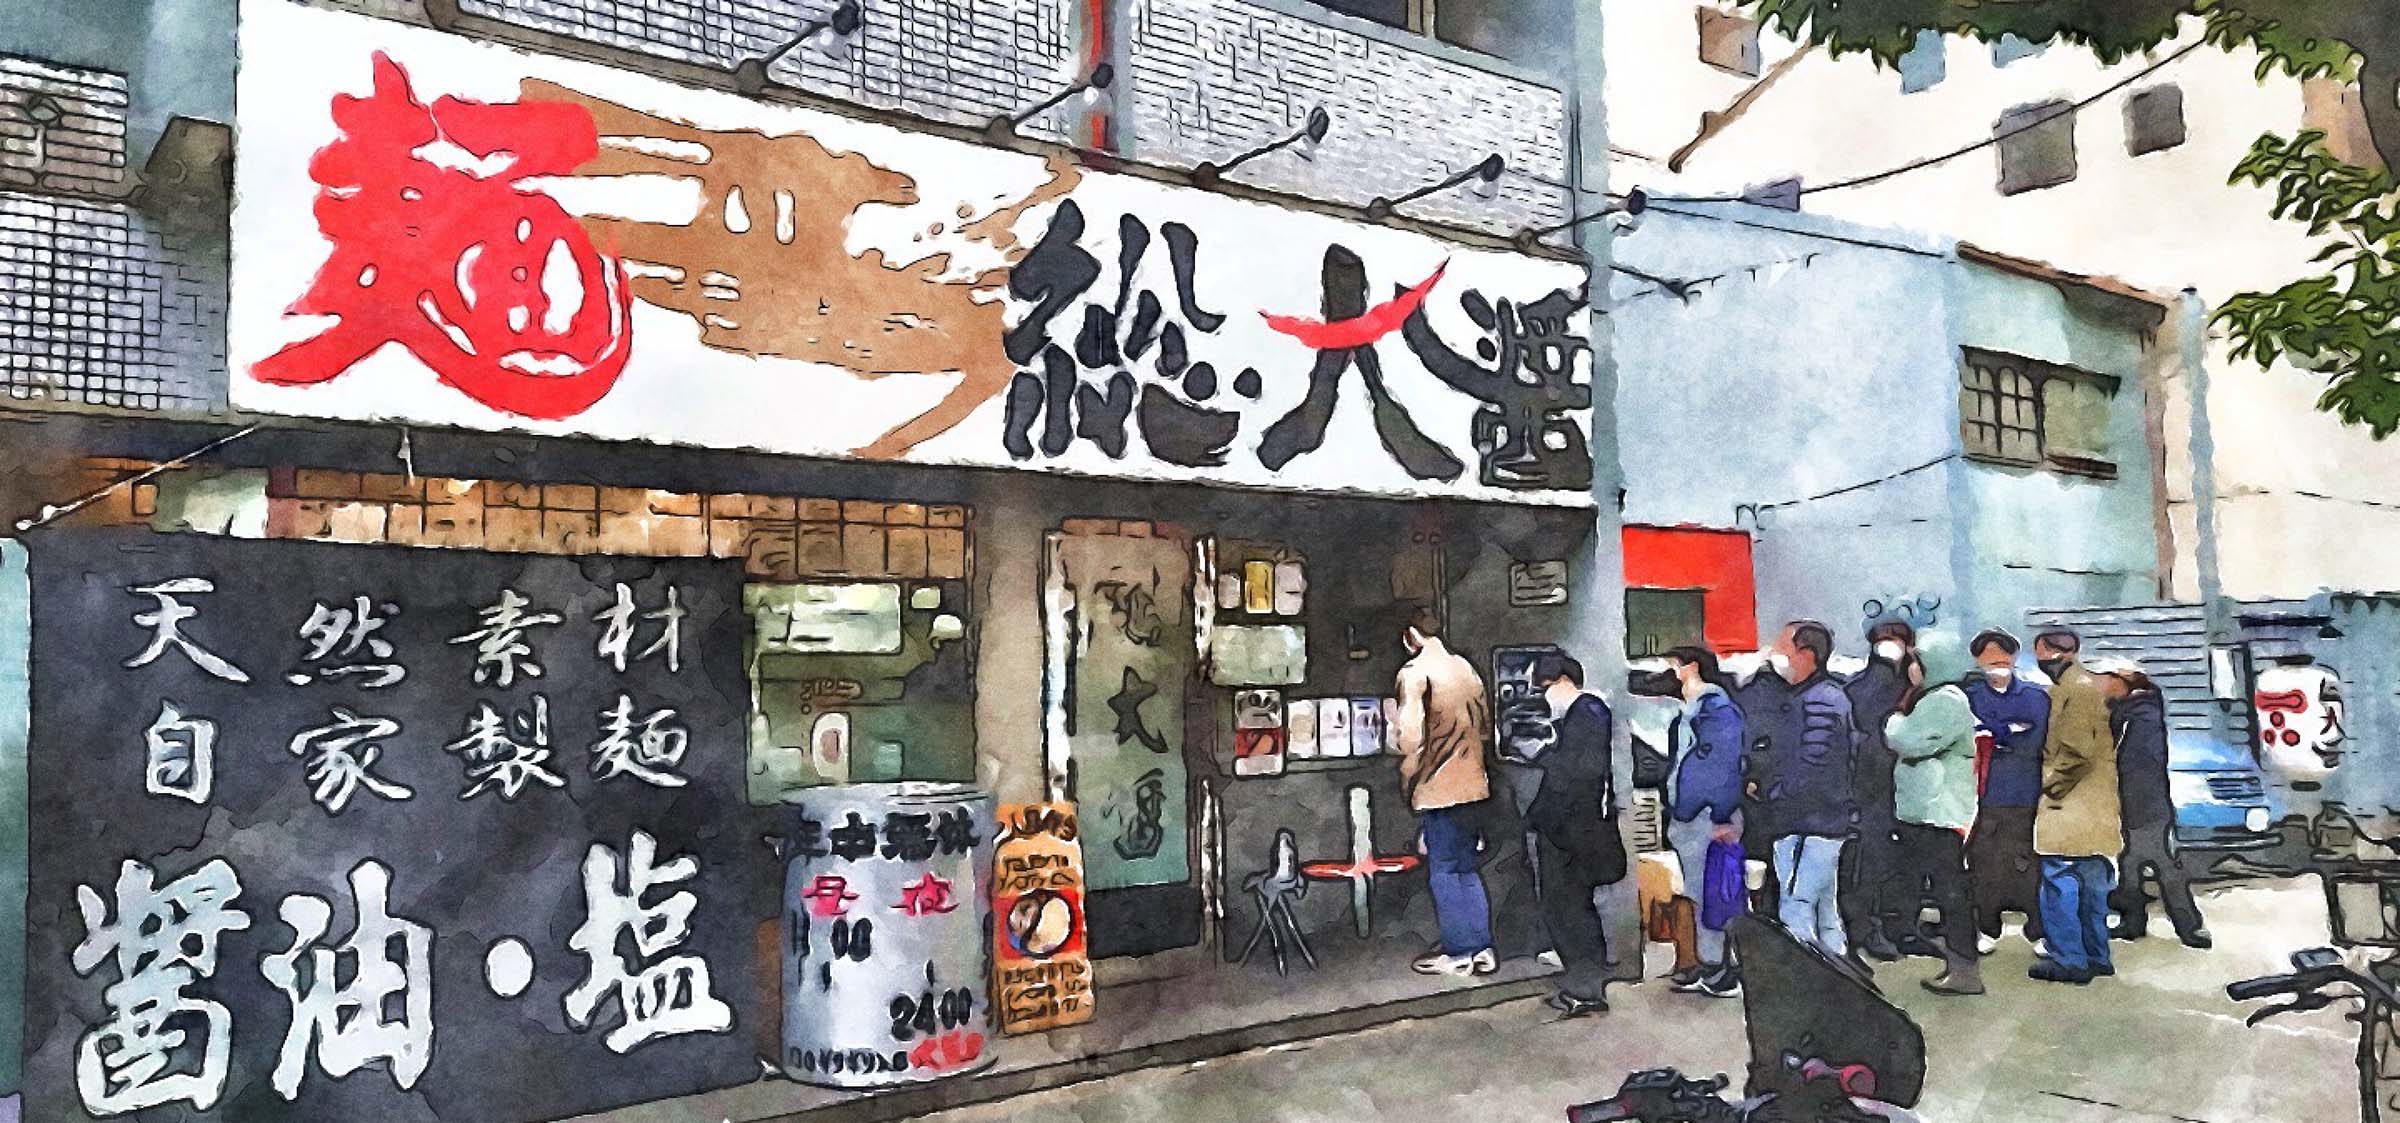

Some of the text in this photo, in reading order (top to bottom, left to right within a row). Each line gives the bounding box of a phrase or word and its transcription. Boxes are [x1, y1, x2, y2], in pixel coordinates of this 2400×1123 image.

[124, 578, 689, 688] 天然素材
[144, 695, 690, 817] 自家製麺
